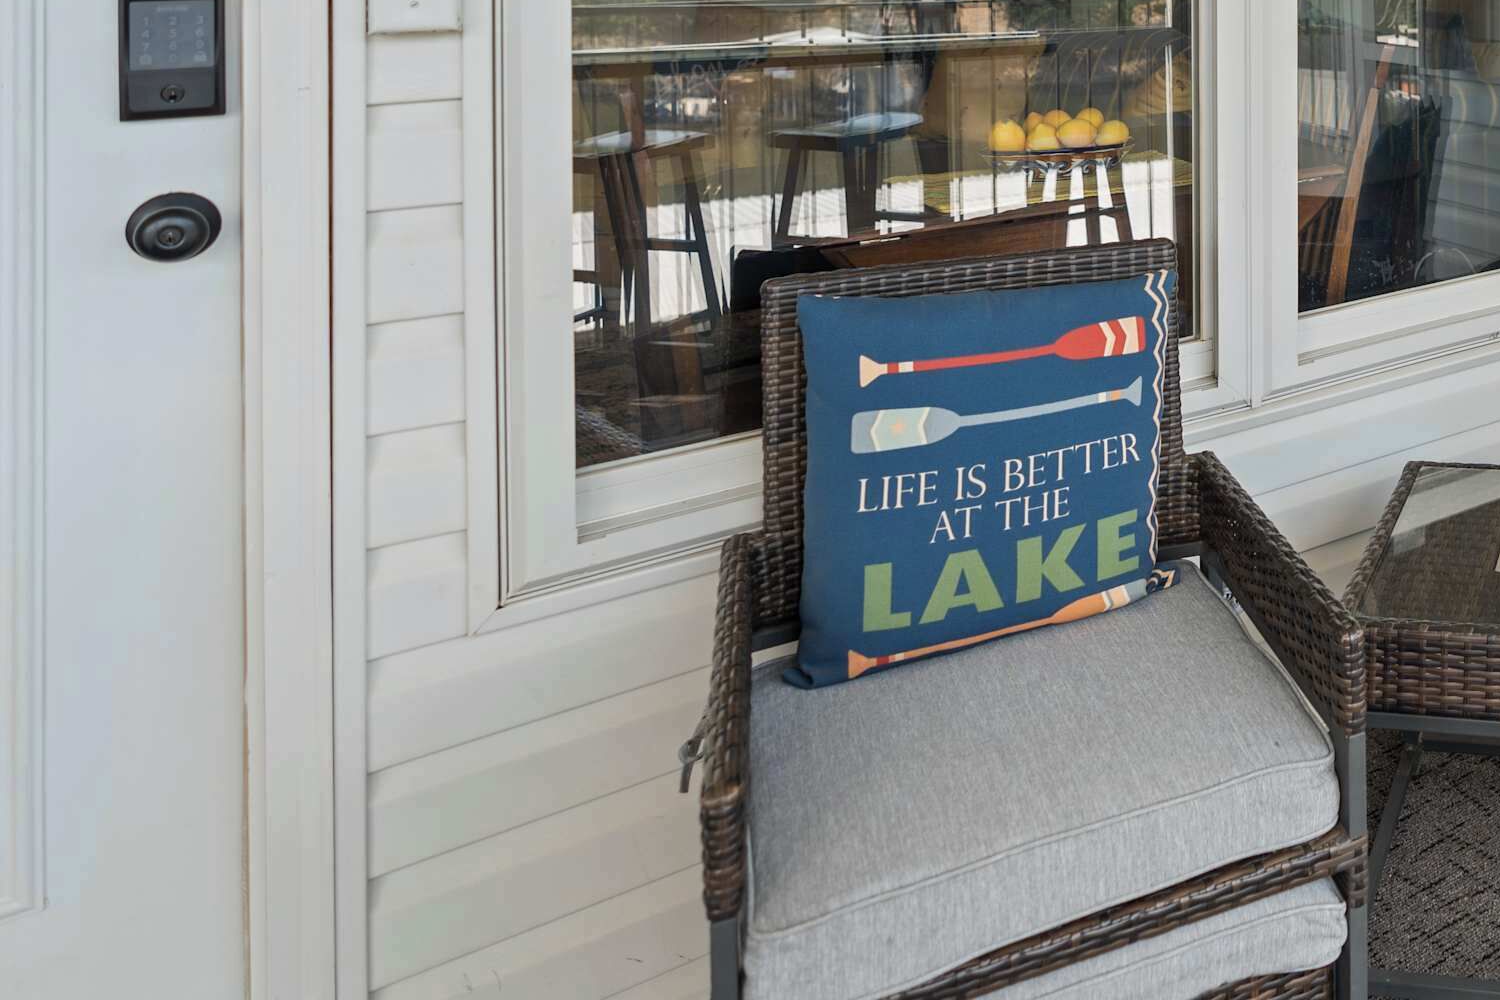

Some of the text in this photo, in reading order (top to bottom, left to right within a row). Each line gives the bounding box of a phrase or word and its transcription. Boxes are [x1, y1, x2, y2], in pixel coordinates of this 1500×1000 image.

[856, 432, 1141, 514] LIFE IS BETTER
[929, 486, 1071, 545] AT THE
[862, 508, 1140, 633] LAKE
